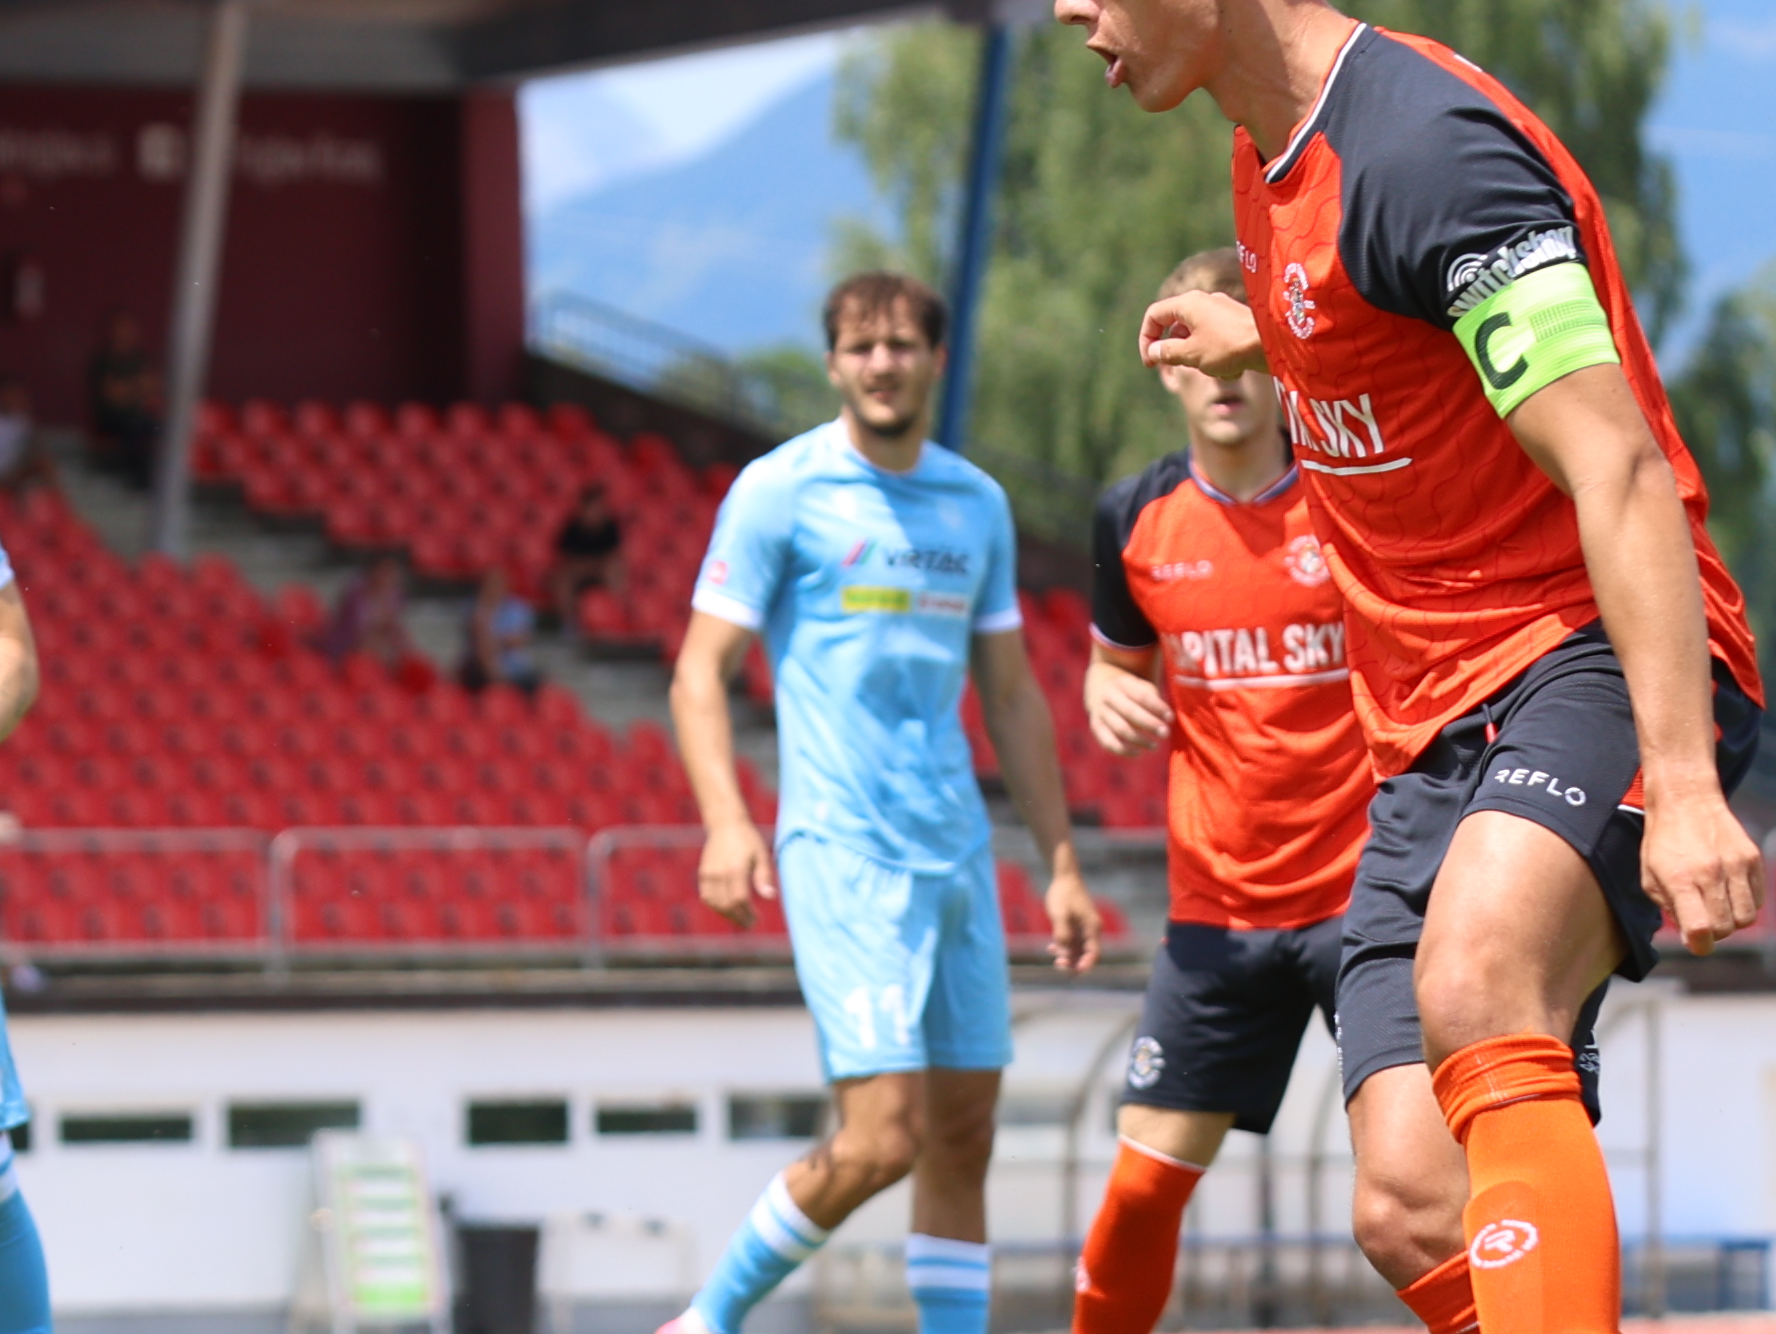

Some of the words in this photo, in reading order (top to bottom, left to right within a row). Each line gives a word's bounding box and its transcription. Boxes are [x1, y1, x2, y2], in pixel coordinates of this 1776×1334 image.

[1475, 310, 1529, 390] C
[1309, 393, 1384, 458] SKY
[1282, 620, 1344, 673] SKY
[1494, 768, 1587, 806] REFLO
[843, 984, 911, 1050] 11
